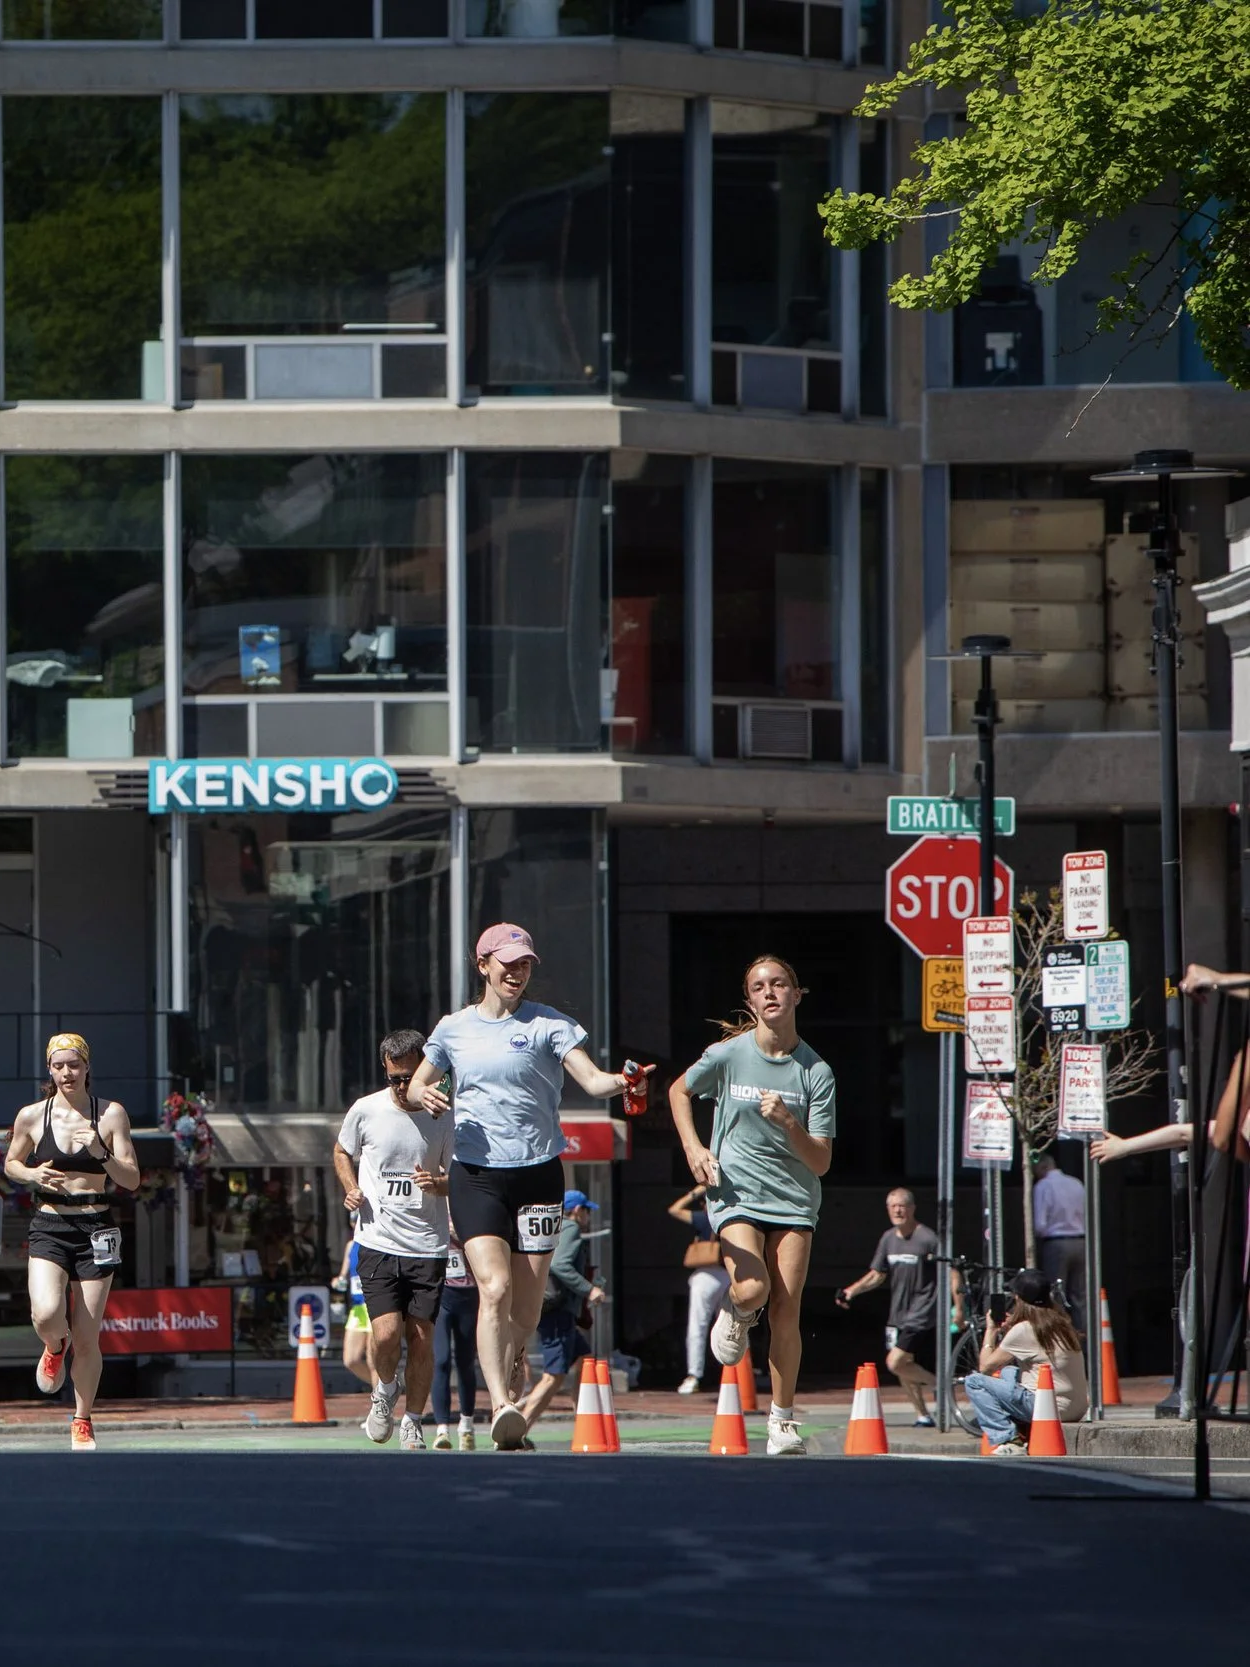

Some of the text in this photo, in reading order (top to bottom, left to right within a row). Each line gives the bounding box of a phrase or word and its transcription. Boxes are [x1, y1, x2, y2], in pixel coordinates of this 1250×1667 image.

[154, 763, 394, 807] KENSHO
[898, 803, 981, 828] BRATTLE
[1068, 855, 1104, 868] TOW ZONE
[1080, 873, 1091, 883] NO
[1069, 885, 1102, 897] PARKING
[1073, 899, 1098, 909] LOADING
[982, 938, 994, 947] NO
[969, 951, 1009, 961] STOPPING
[1089, 946, 1098, 965] 2
[934, 964, 963, 975] 2-WAY
[984, 1014, 996, 1023] NO
[1051, 1008, 1079, 1023] 6920
[972, 1024, 1008, 1034] PARKING
[387, 1180, 412, 1197] 770
[528, 1215, 561, 1237] 502
[99, 1311, 219, 1332] vestruck Books
